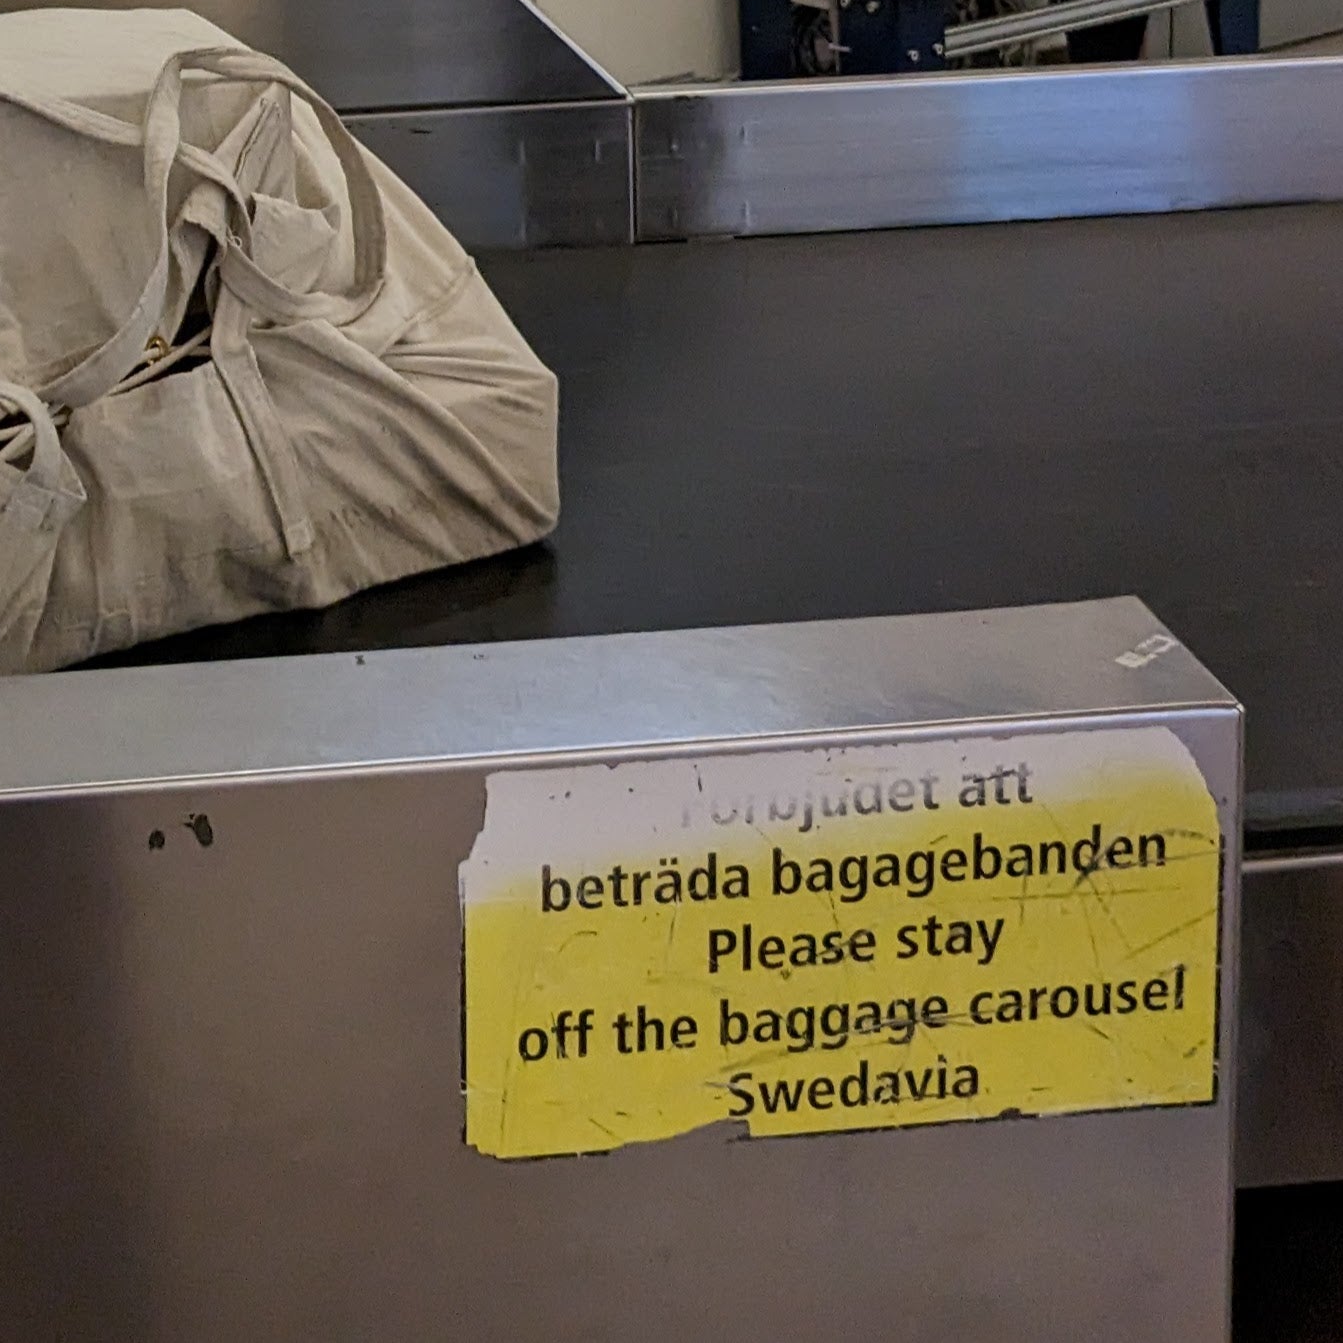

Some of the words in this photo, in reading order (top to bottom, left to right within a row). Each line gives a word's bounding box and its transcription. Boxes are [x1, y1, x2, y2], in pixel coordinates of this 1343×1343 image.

[958, 762, 1033, 807] att
[541, 853, 749, 912] beträda
[772, 824, 1167, 903] bagagebanden
[708, 923, 876, 973] Please
[897, 915, 1005, 964] stay
[518, 1008, 595, 1062] off
[612, 1005, 698, 1054] the
[720, 992, 948, 1053] baggage
[969, 964, 1185, 1025] carousel
[727, 1055, 980, 1117] Swedavia
